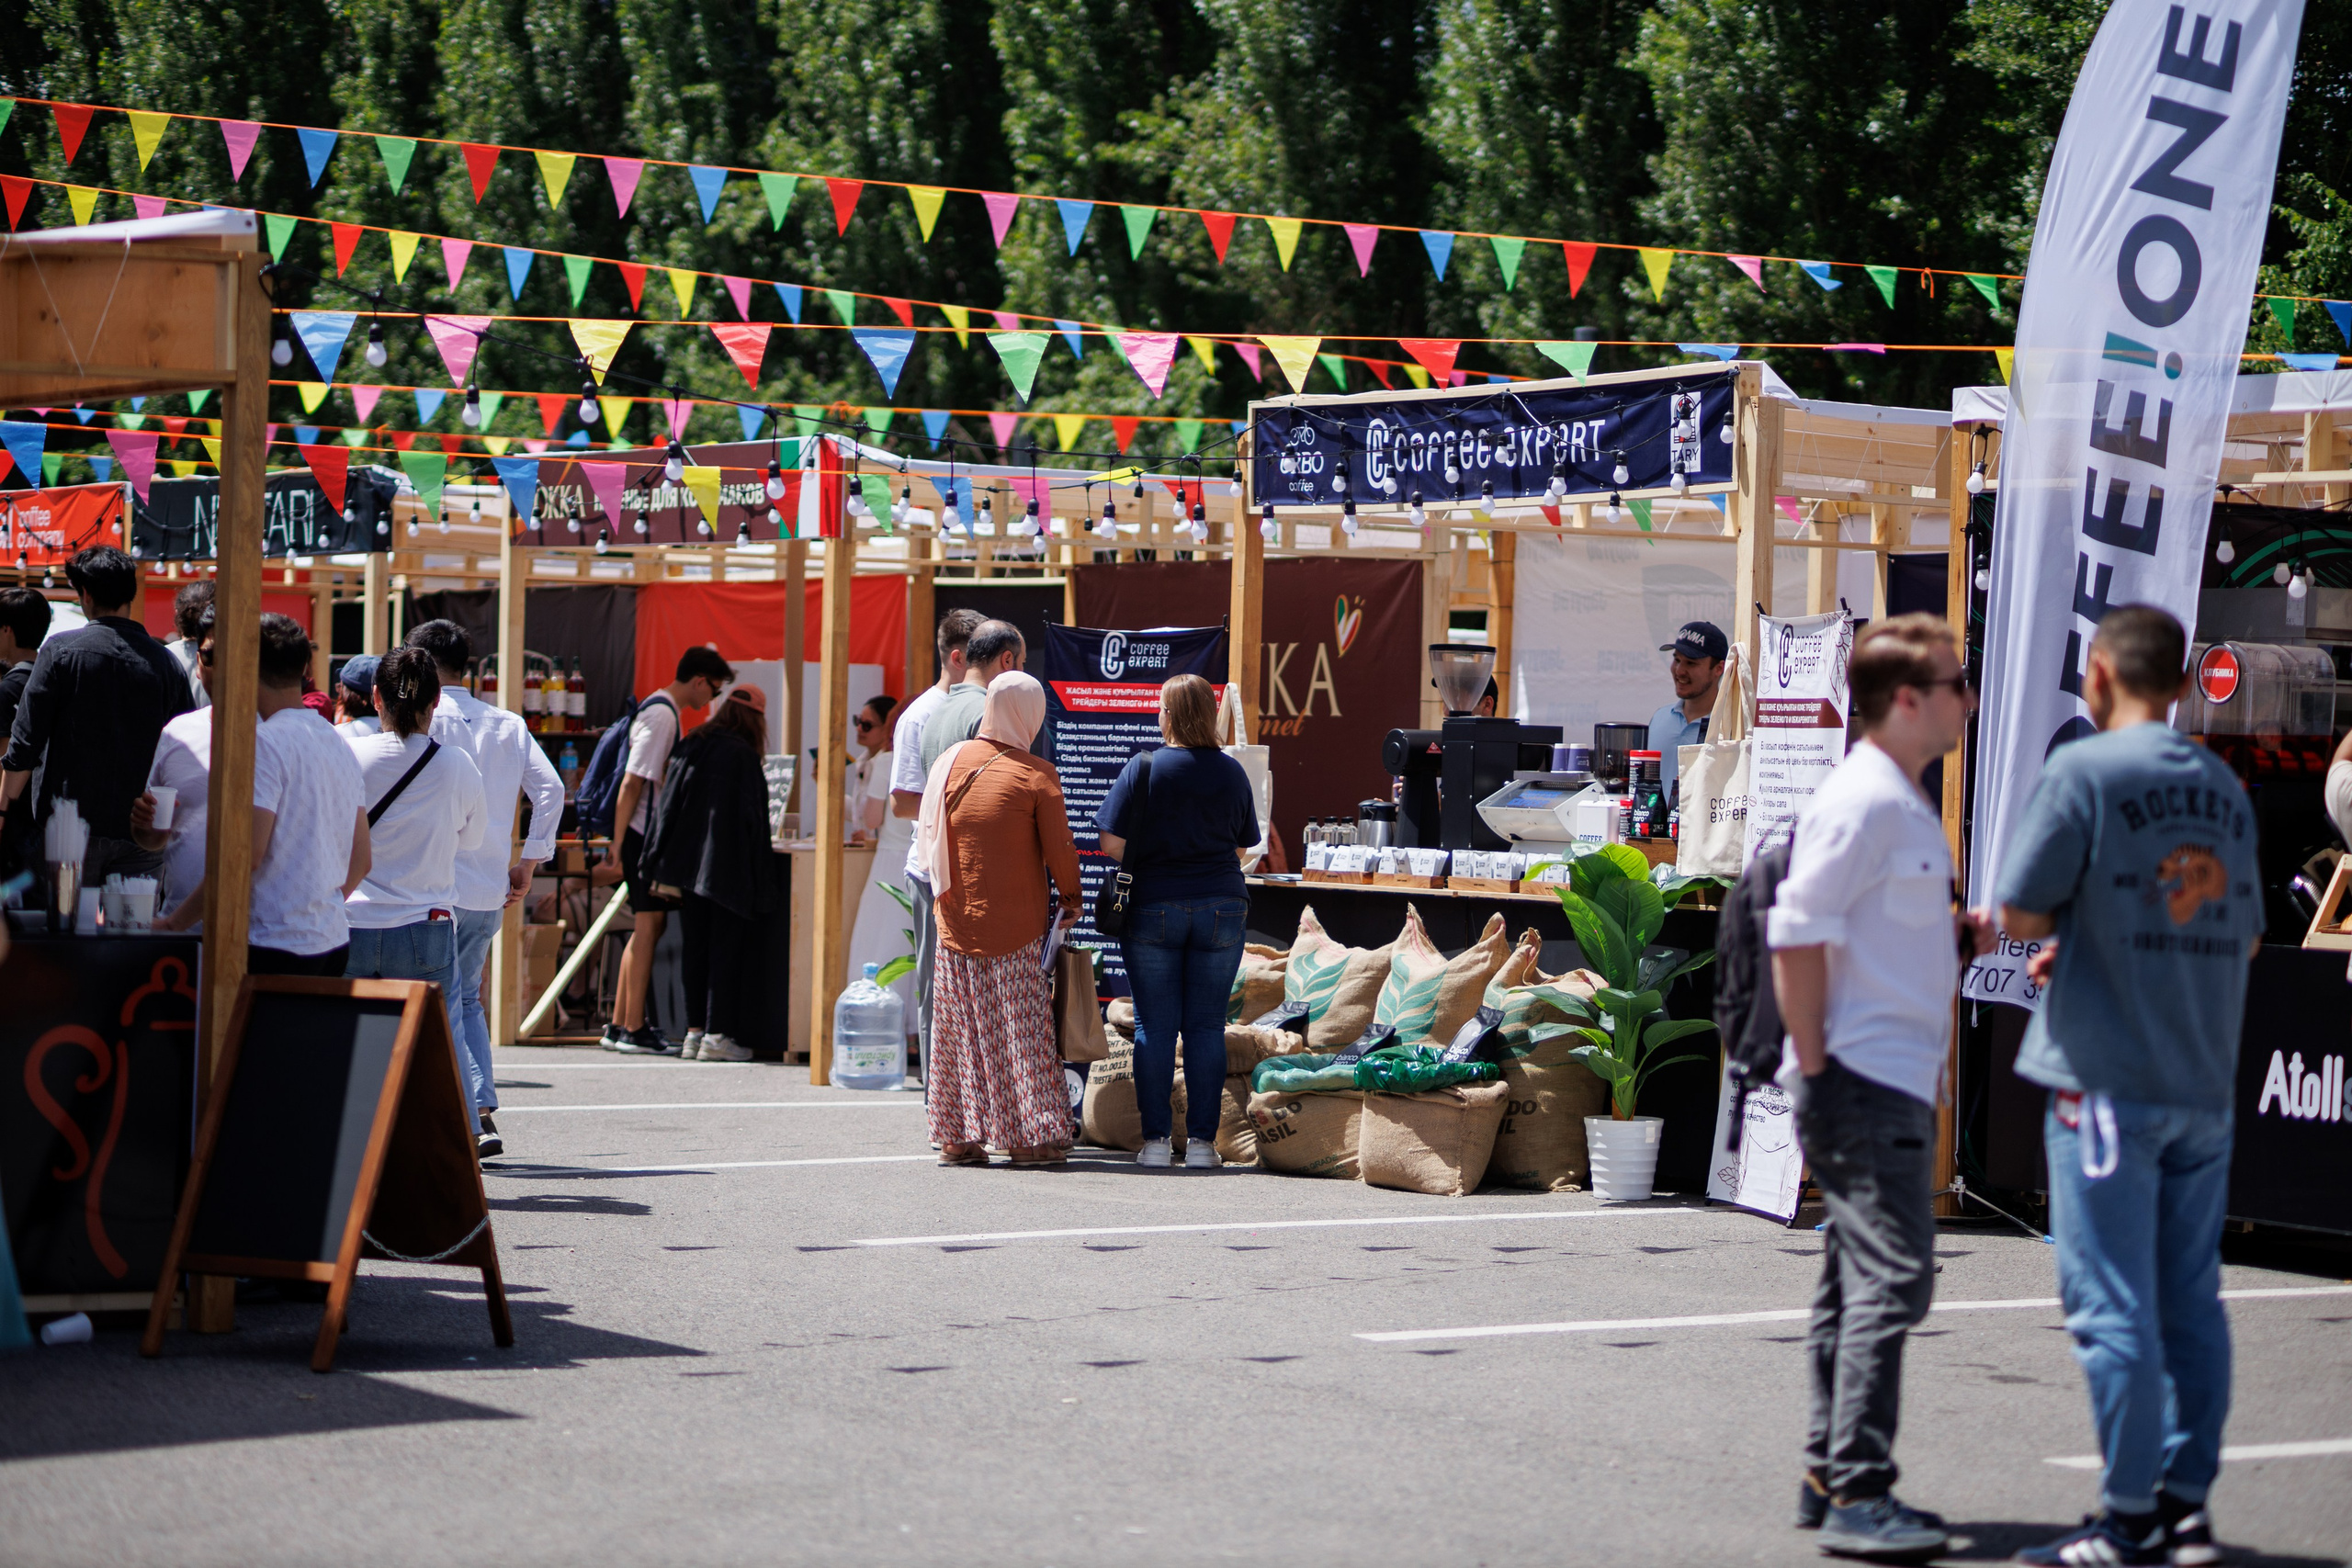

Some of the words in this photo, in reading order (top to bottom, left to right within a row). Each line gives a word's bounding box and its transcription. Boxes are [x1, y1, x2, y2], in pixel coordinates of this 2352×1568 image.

[1671, 448, 1700, 463] TARY
[1288, 479, 1315, 492] coffee
[650, 487, 679, 512] ДЛЯ
[18, 505, 51, 528] coffee
[17, 529, 66, 556] company
[1260, 642, 1343, 716] KA
[2204, 668, 2234, 678] КЛУБНИКА
[1066, 687, 1091, 695] ЖАСЫЛ
[1071, 696, 1108, 707] ТРЕЙДЕРЫ
[1057, 721, 1078, 730] Біздің
[1078, 723, 1114, 731] компания
[1114, 724, 1140, 732] кофені
[1056, 743, 1078, 752] Біздің
[1060, 753, 1082, 762] Сіздің
[1085, 863, 1104, 873] день
[1995, 930, 2041, 960] ffee
[1335, 1054, 1359, 1062] bianco
[1507, 1100, 1538, 1116] DO
[1250, 1110, 1269, 1129] ES
[1498, 1118, 1517, 1135] IL
[1256, 1122, 1297, 1145] ASIL
